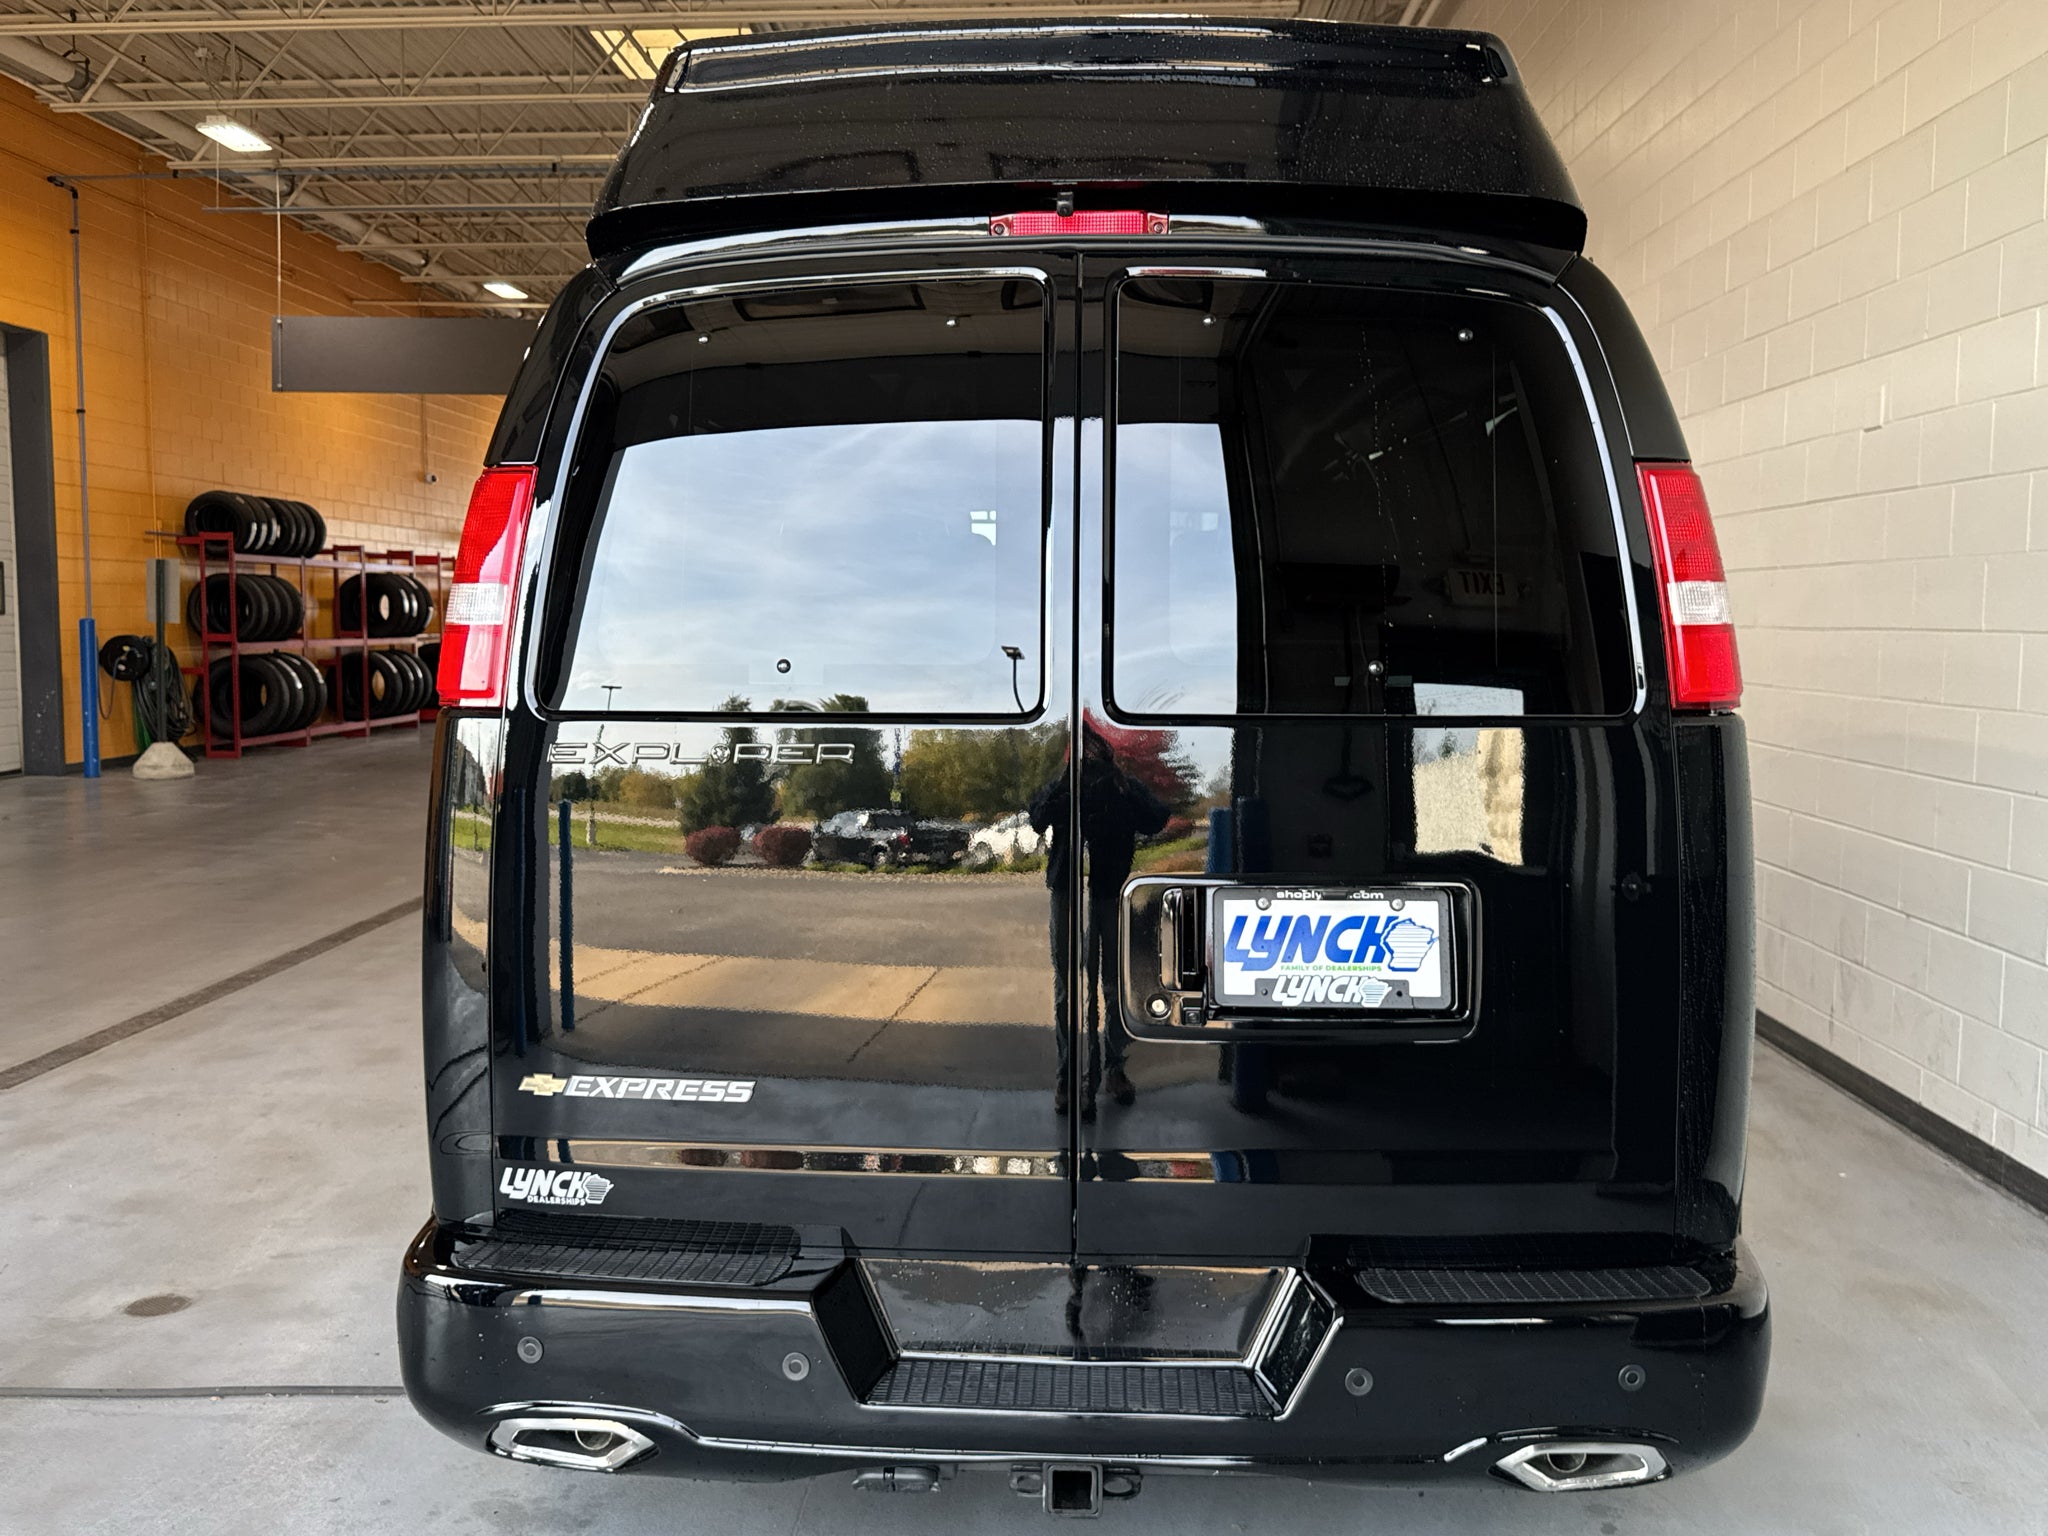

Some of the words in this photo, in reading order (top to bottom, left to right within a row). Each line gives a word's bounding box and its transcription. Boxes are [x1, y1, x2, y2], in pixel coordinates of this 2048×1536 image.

[546, 742, 855, 765] EXPLORER
[1276, 889, 1384, 901] shoply.com
[1223, 914, 1400, 972] LYNCH
[1280, 964, 1310, 972] FAMILY
[1312, 964, 1323, 972] OF
[1272, 974, 1371, 1007] LYNCH
[563, 1075, 757, 1103] EXPRESS
[499, 1167, 592, 1200] LYNCH
[527, 1195, 586, 1207] DEALERSHIPS
